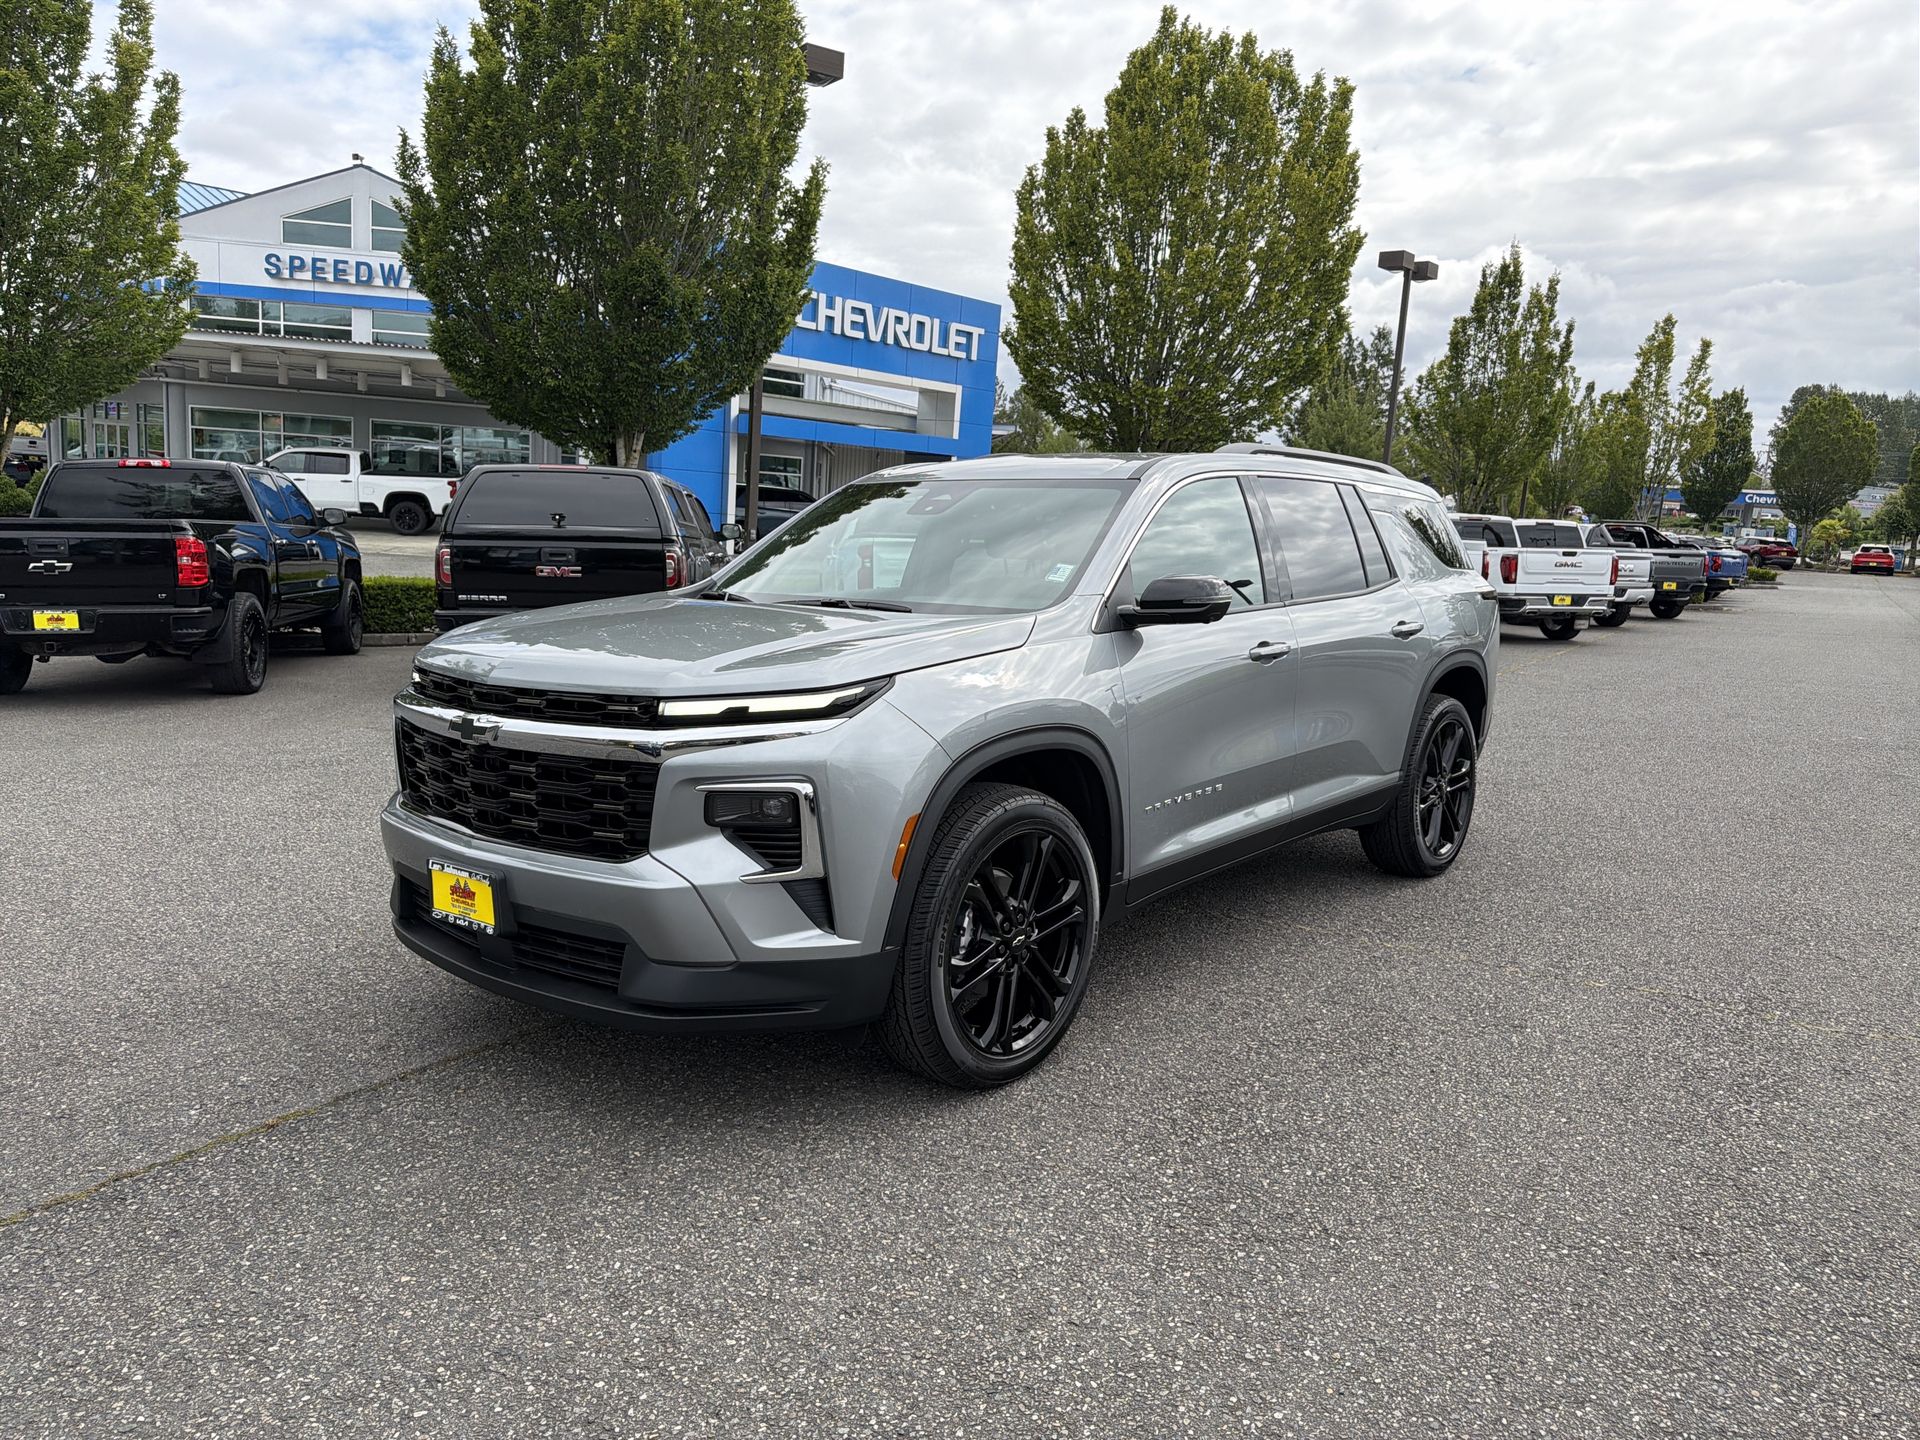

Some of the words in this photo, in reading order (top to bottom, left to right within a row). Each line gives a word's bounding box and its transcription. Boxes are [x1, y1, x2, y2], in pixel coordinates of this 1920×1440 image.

[264, 253, 416, 289] SPEEDW
[796, 289, 985, 361] CHEVROLET
[536, 565, 582, 577] GMC
[1144, 783, 1223, 815] TRAVERSE
